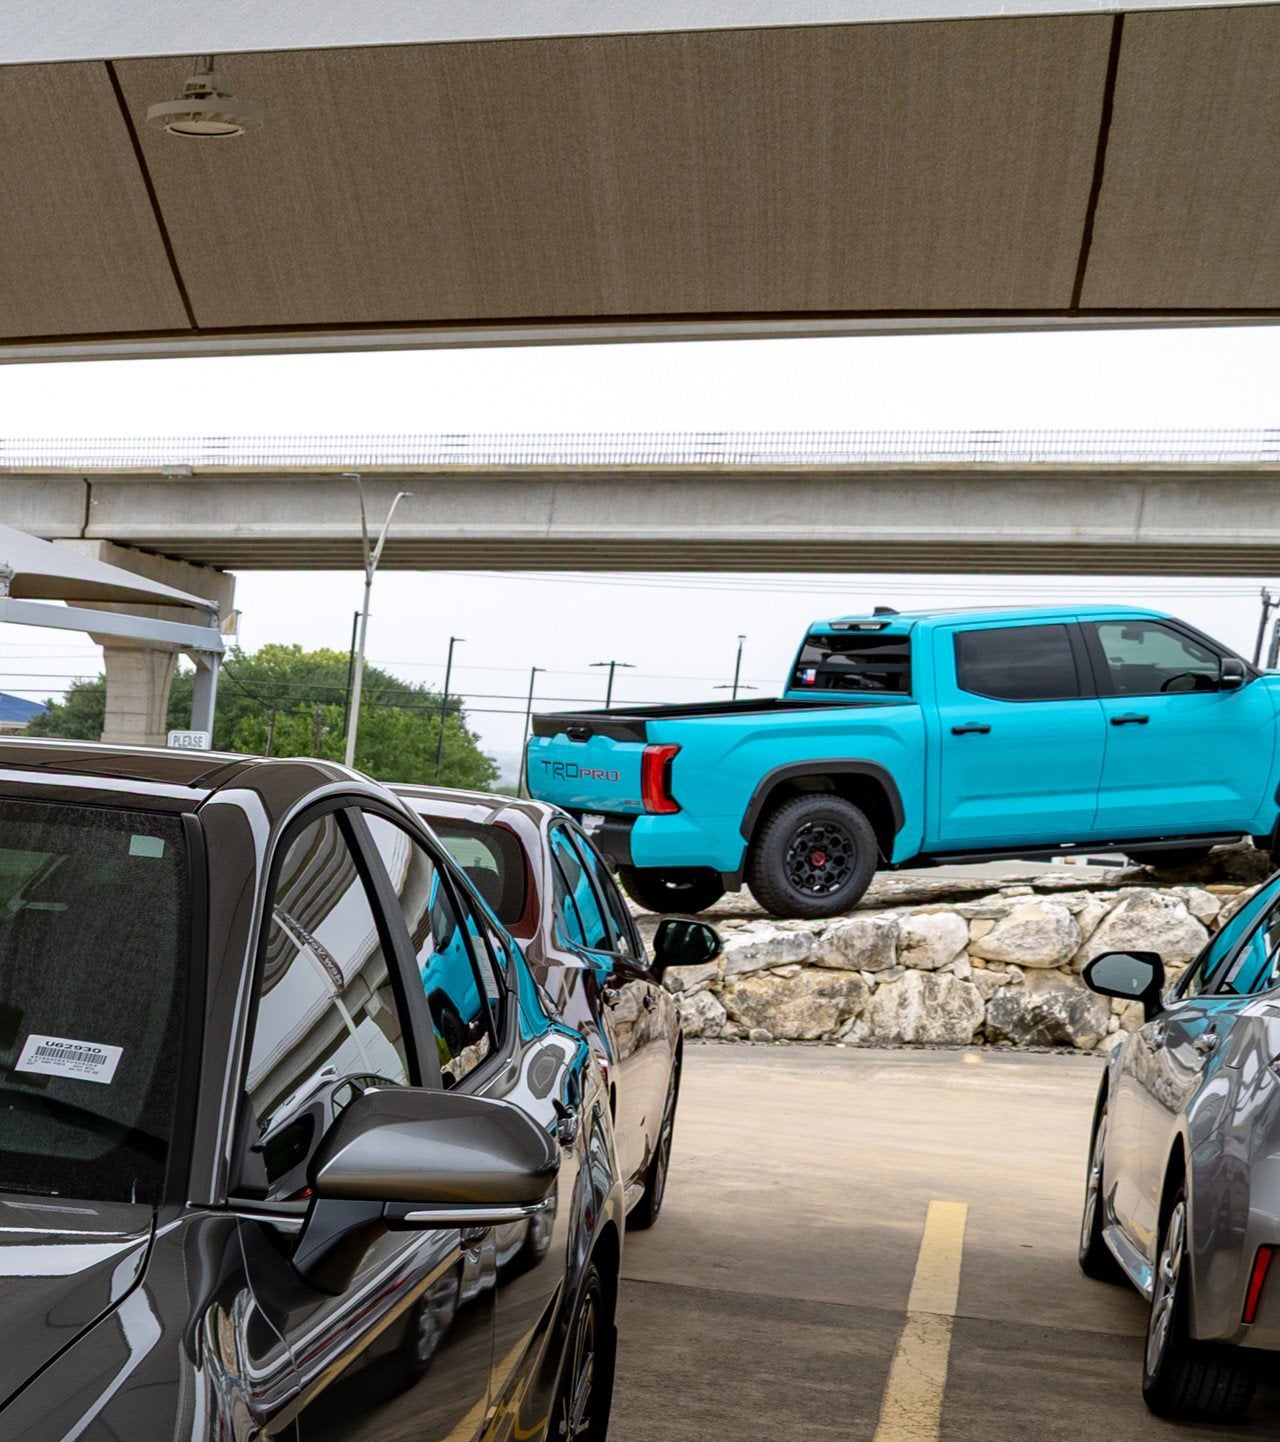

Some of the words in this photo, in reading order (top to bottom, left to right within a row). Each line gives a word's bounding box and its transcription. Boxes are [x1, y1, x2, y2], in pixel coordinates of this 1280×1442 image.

[172, 734, 203, 748] PLEASE
[541, 760, 579, 781] TRD
[579, 768, 620, 782] PRO
[45, 1040, 102, 1054] U62930
